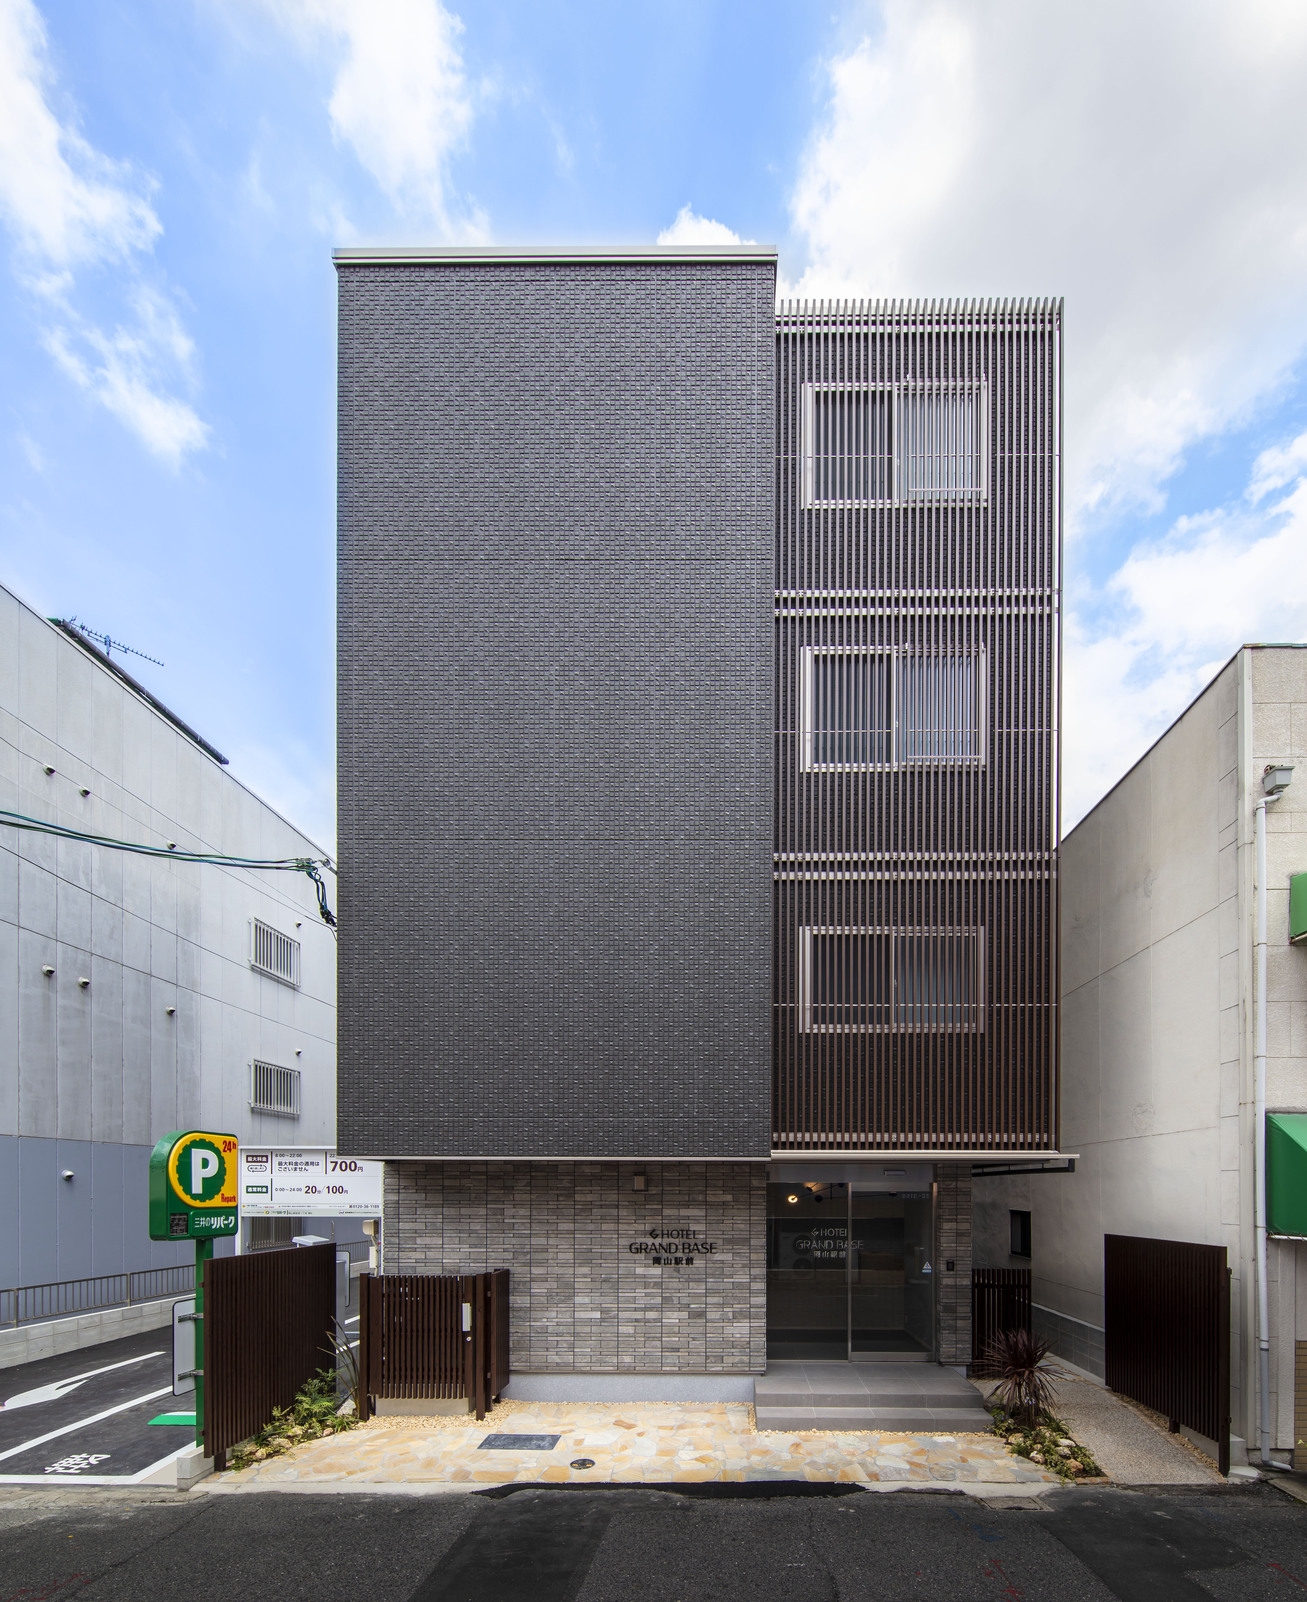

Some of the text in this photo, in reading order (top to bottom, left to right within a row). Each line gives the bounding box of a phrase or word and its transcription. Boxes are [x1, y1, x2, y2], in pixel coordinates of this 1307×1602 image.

[191, 1148, 219, 1195] P
[661, 1229, 700, 1240] HOTEL
[629, 1242, 718, 1255] GRAND BASE
[796, 1239, 834, 1250] GRAND
